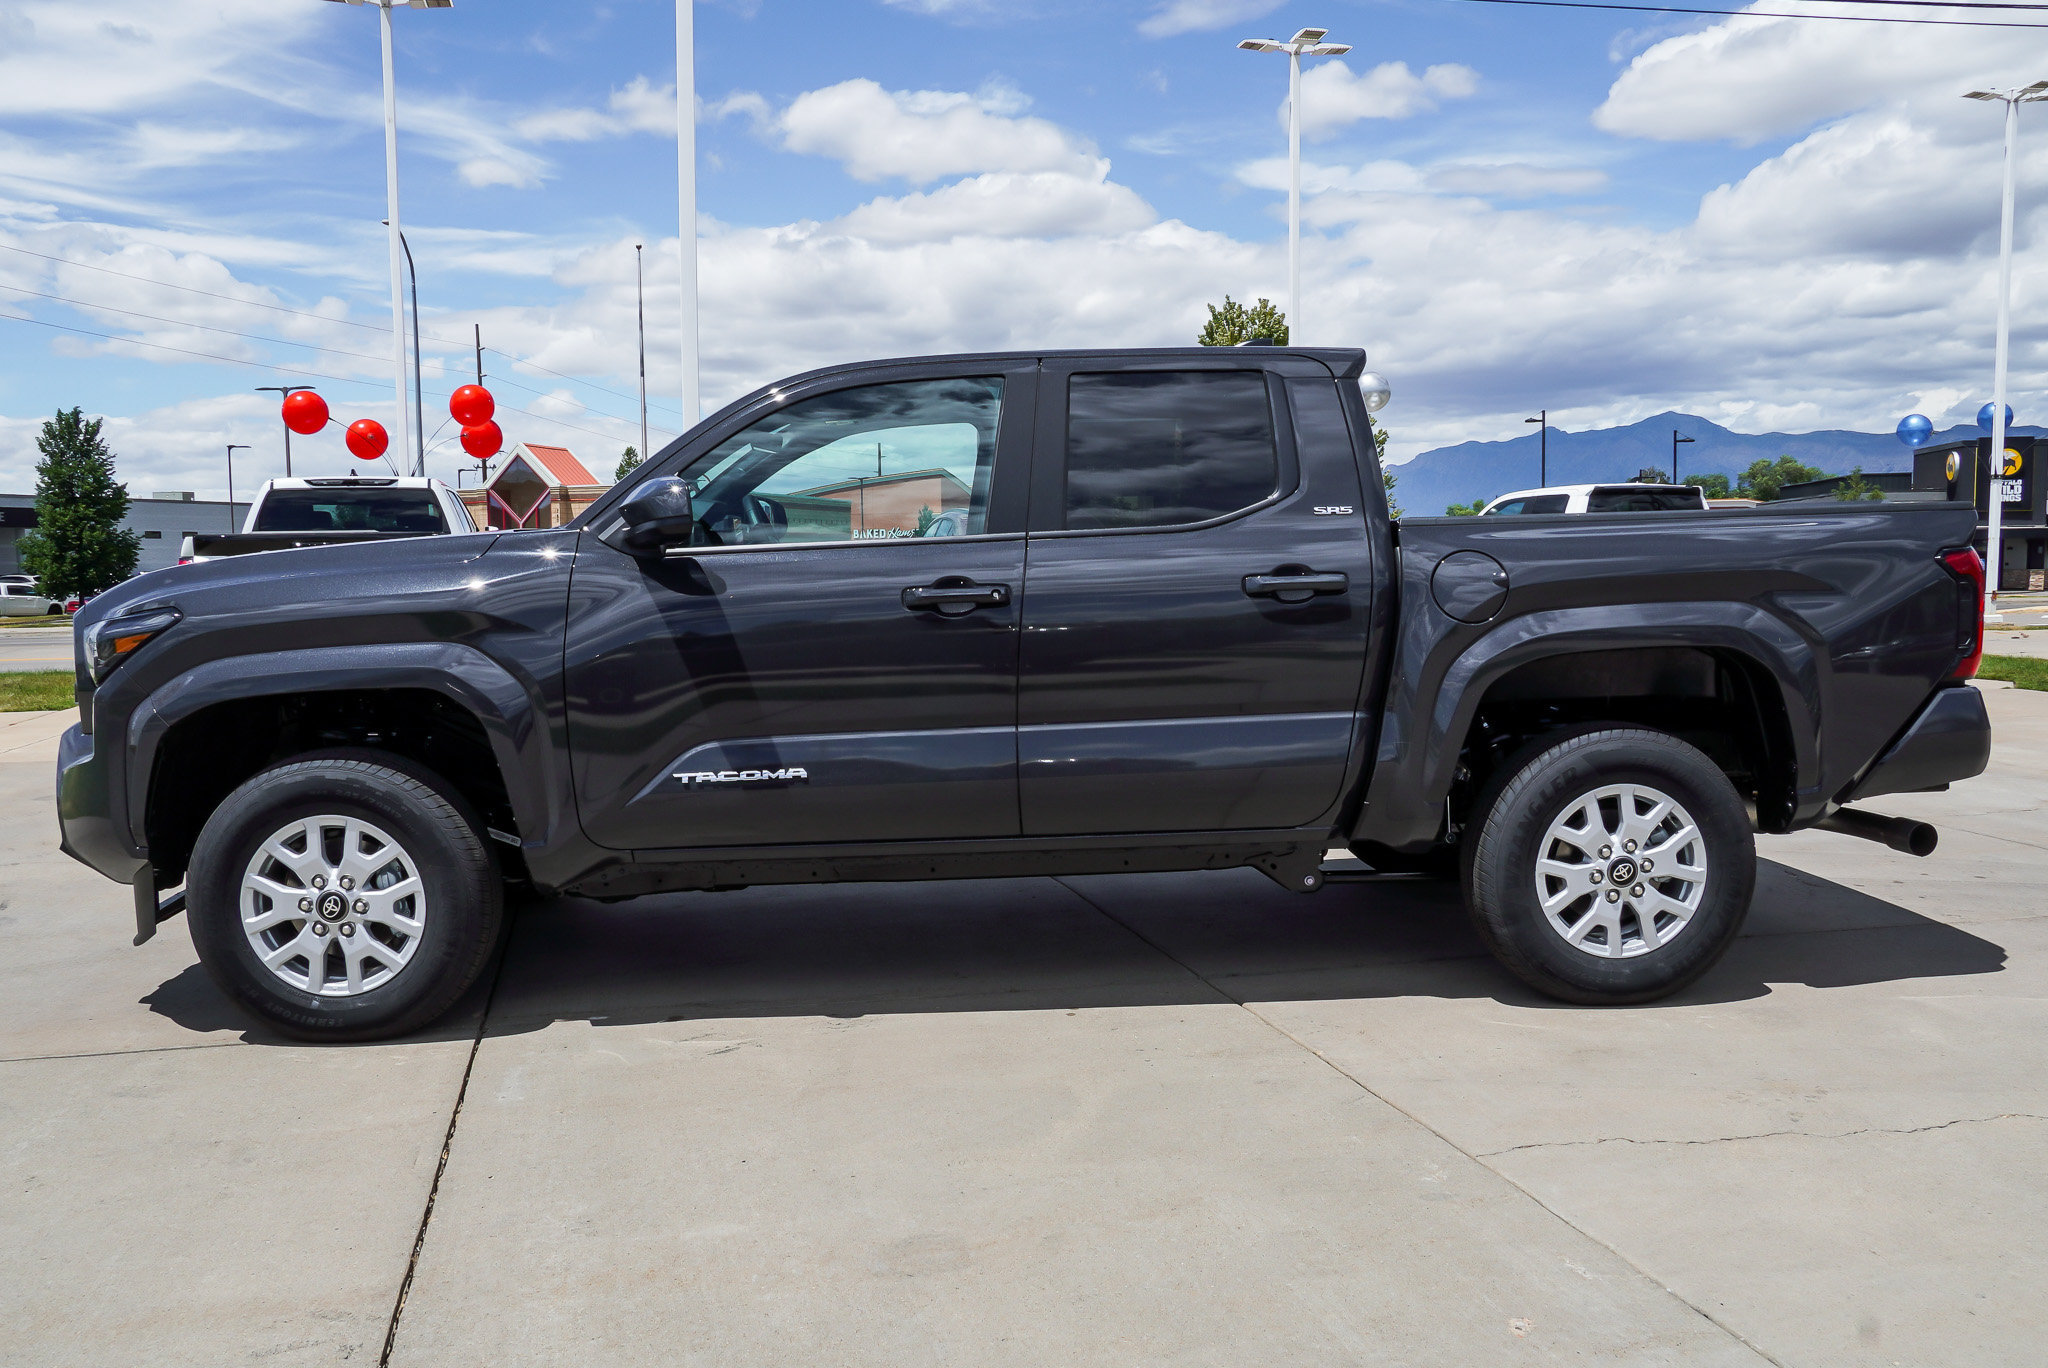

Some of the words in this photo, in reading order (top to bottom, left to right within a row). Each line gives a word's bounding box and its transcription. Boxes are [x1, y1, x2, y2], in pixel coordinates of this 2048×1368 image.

[2002, 485, 2022, 495] ILD
[1313, 505, 1354, 515] SR5
[853, 528, 886, 539] BAKED
[672, 767, 808, 784] TACOMA
